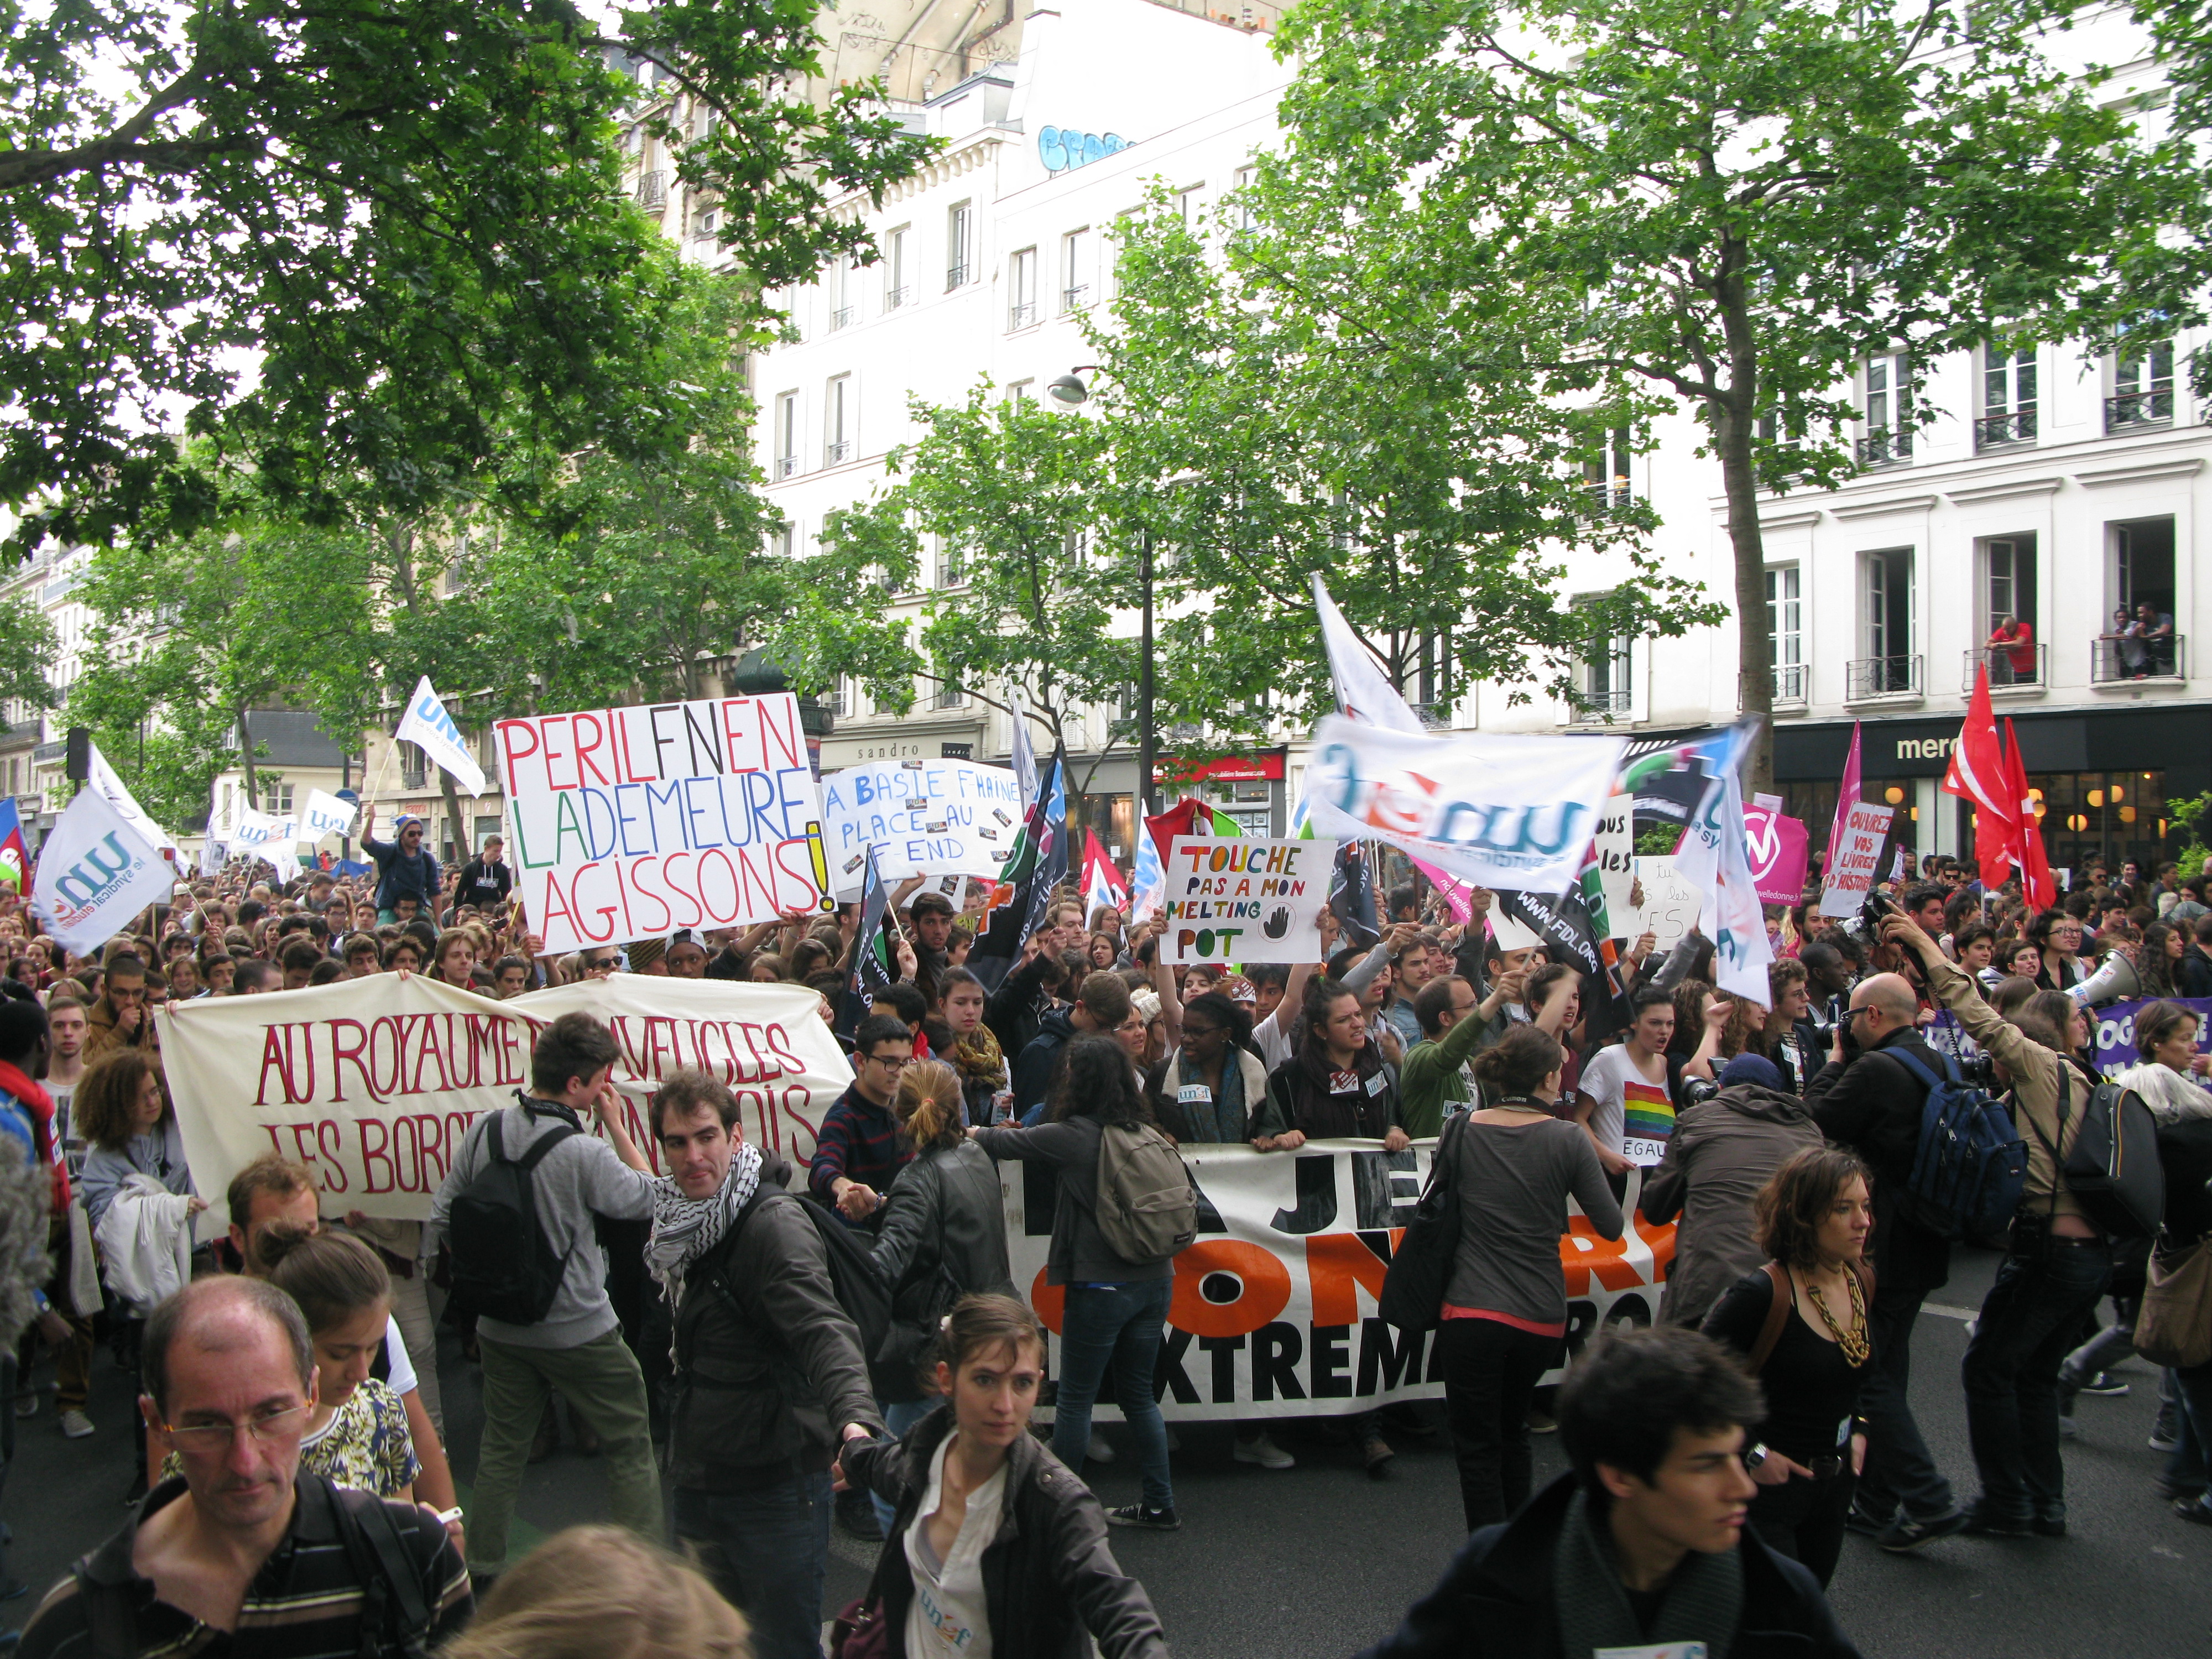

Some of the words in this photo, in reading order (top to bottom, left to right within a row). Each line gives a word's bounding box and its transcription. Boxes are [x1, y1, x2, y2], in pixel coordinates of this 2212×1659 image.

[858, 743, 919, 759] sandro
[826, 785, 846, 819] A
[842, 810, 927, 850] PLACE
[947, 805, 972, 827] AU
[1849, 811, 1893, 834] OUVREZ
[1854, 835, 1874, 853] VOS
[1180, 844, 1302, 876] TOUCHE
[1840, 851, 1877, 869] LIVRES
[1186, 877, 1227, 896] PAS
[1260, 878, 1306, 897] MON
[1165, 900, 1261, 920] MELTING
[1177, 927, 1244, 959] POT
[253, 1021, 320, 1107] AU
[315, 1012, 525, 1105] ROYAUME
[1178, 1087, 1210, 1099] unef
